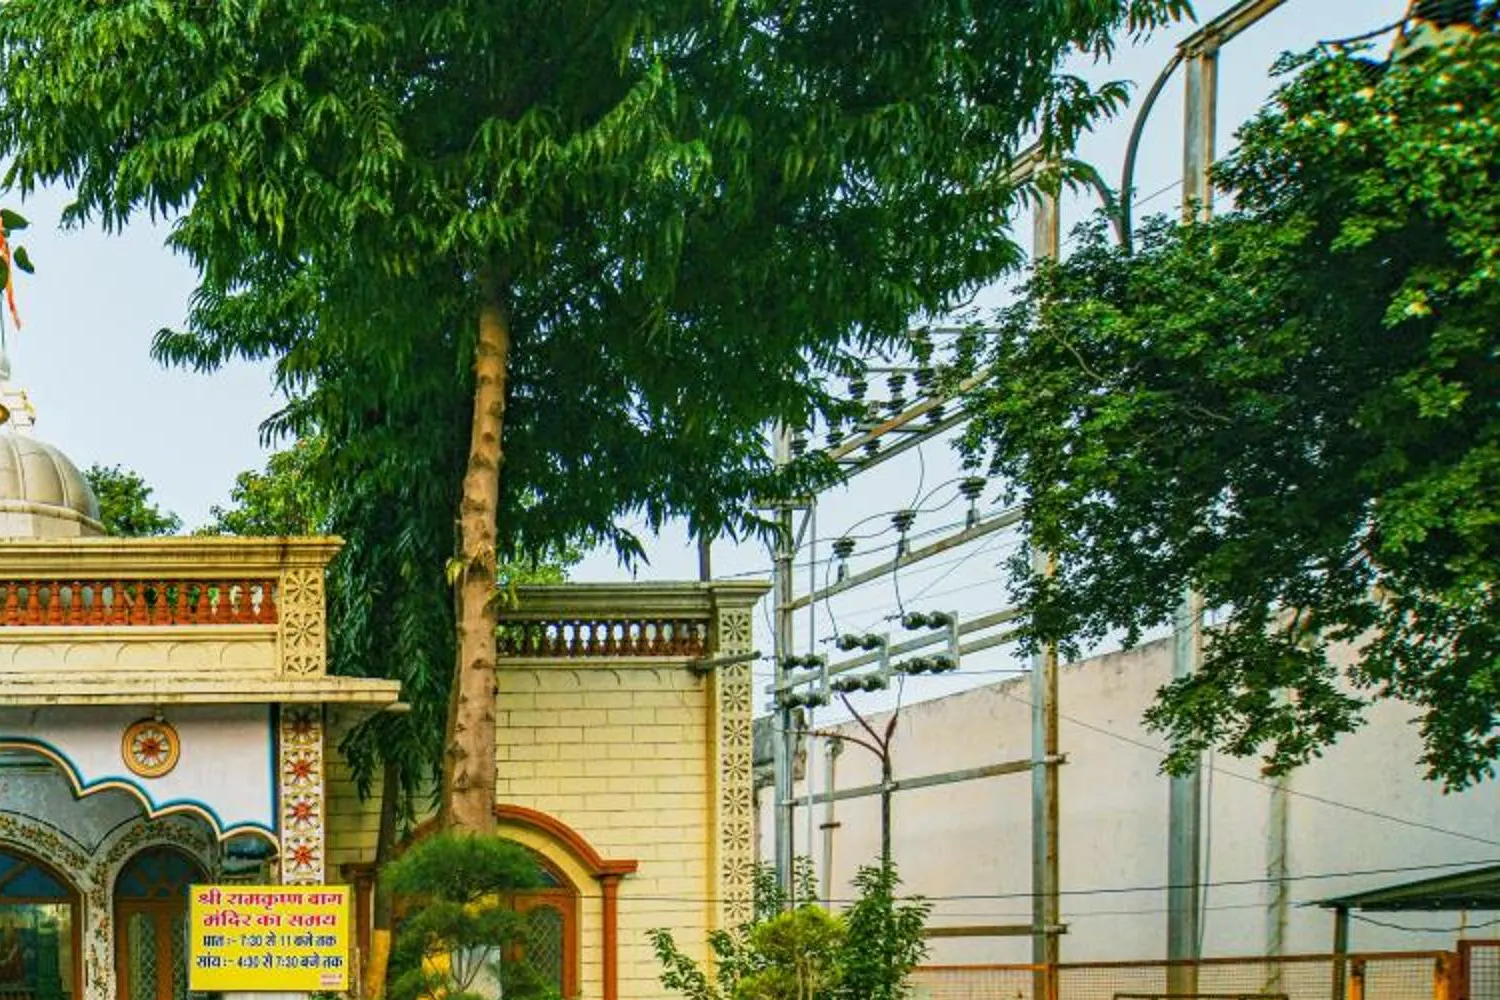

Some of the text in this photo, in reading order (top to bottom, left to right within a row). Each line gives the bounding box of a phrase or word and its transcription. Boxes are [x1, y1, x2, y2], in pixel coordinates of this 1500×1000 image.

[198, 888, 221, 905] श्री
[227, 893, 303, 910] रामकृष्ण
[203, 909, 336, 926] मंदिर का समय
[265, 931, 277, 946] से
[281, 935, 291, 946] 11
[316, 935, 336, 946] तक
[263, 952, 273, 967] से
[323, 956, 343, 967] तक
